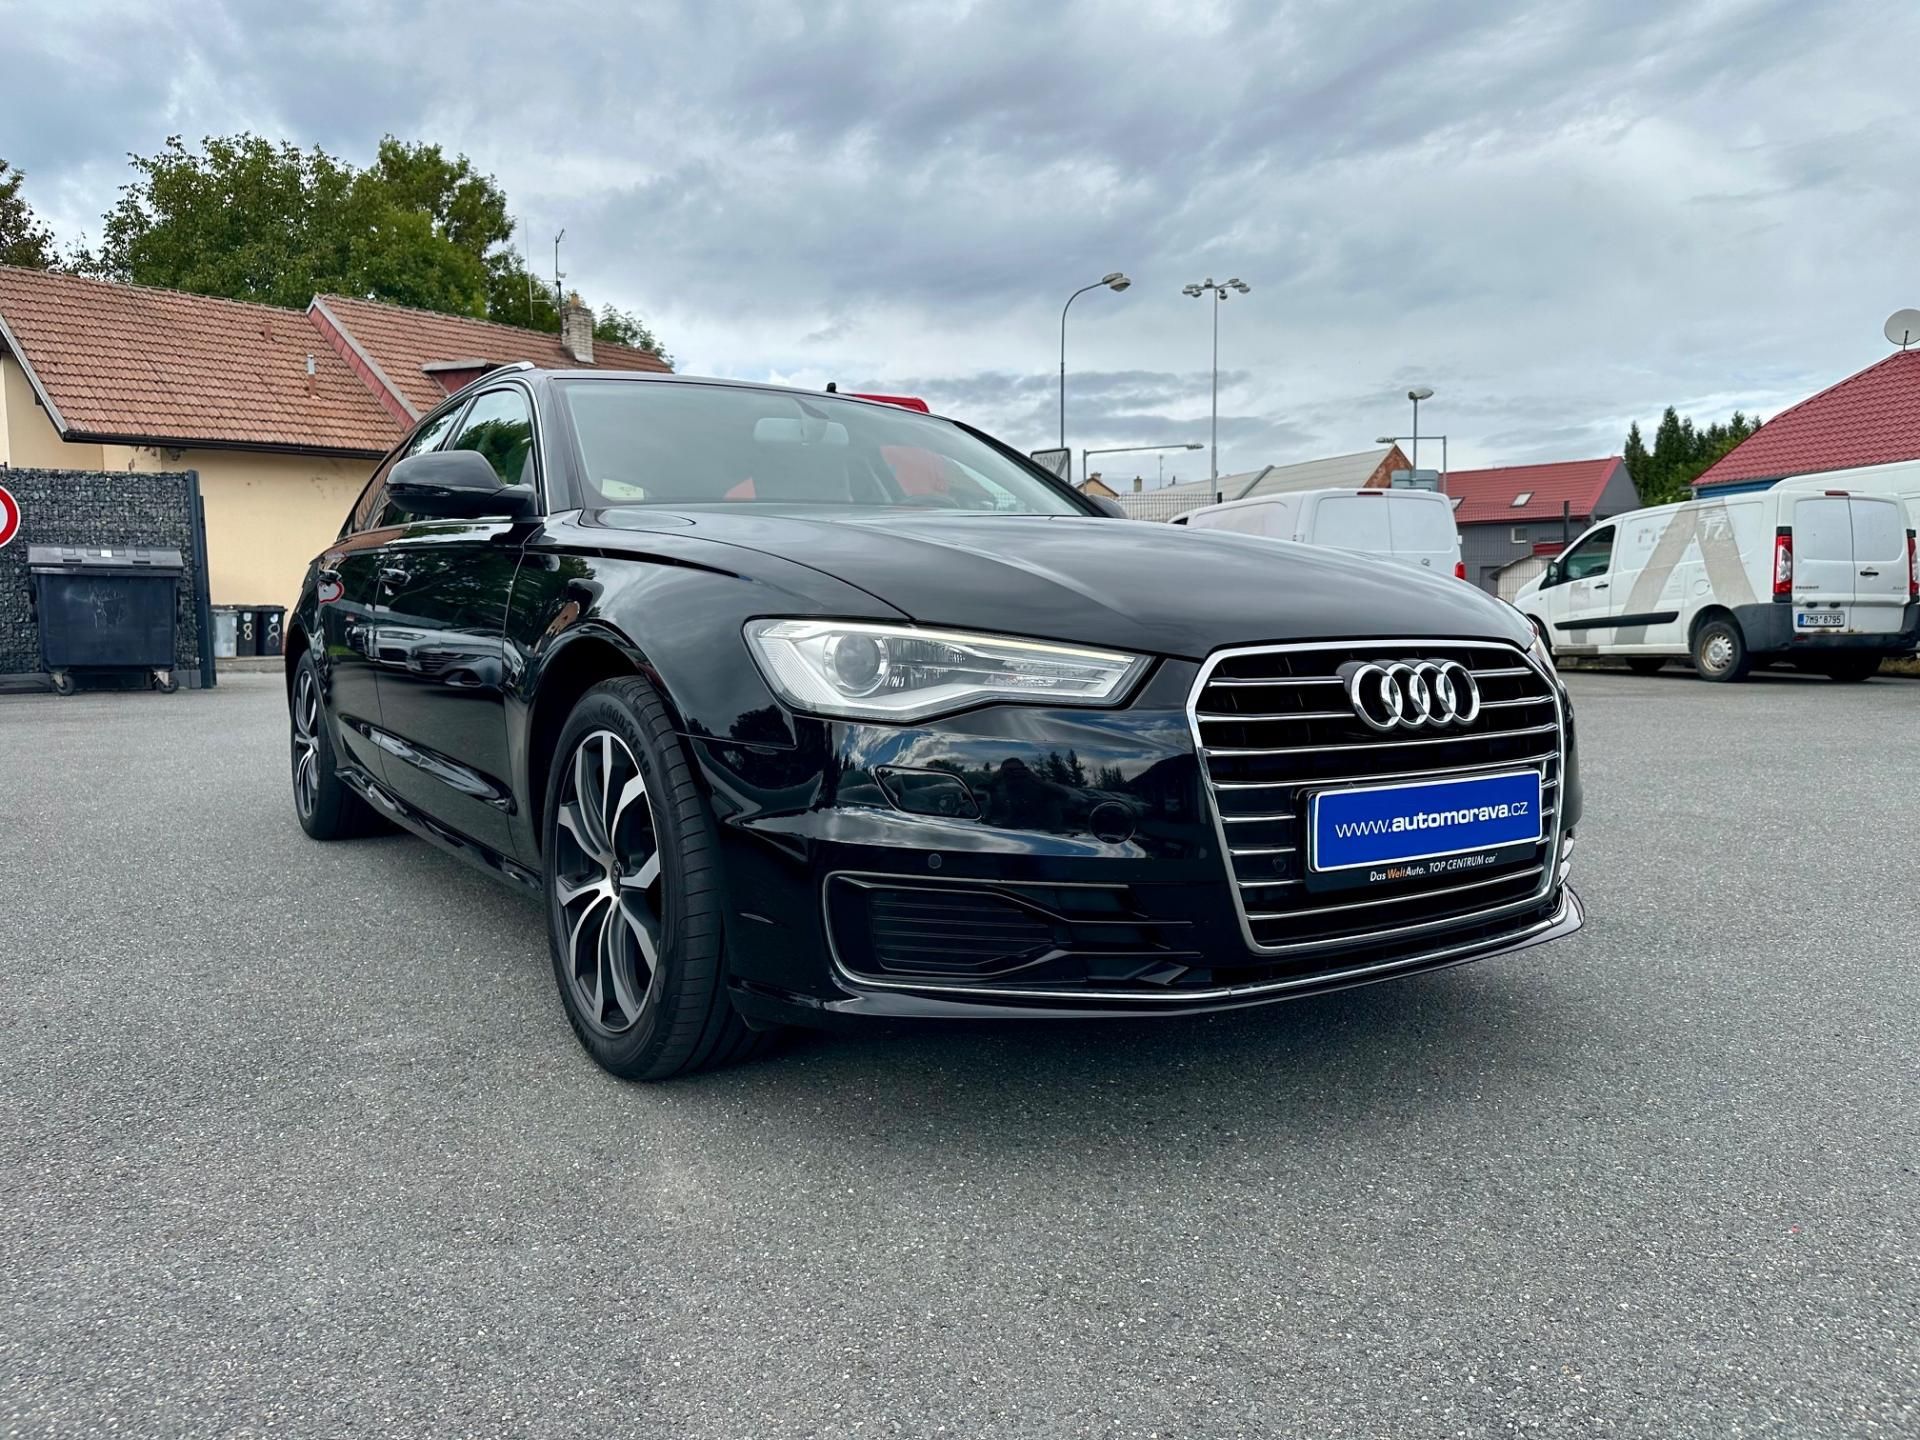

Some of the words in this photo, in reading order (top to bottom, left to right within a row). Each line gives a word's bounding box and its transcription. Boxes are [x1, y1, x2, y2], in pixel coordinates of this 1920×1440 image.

[1823, 615, 1841, 624] 8795
[600, 702, 651, 776] GOODYEAR
[1335, 801, 1528, 838] www.automorava.cz
[1370, 870, 1386, 881] Das
[1429, 861, 1446, 873] TOP
[1447, 855, 1484, 869] CENTRUM
